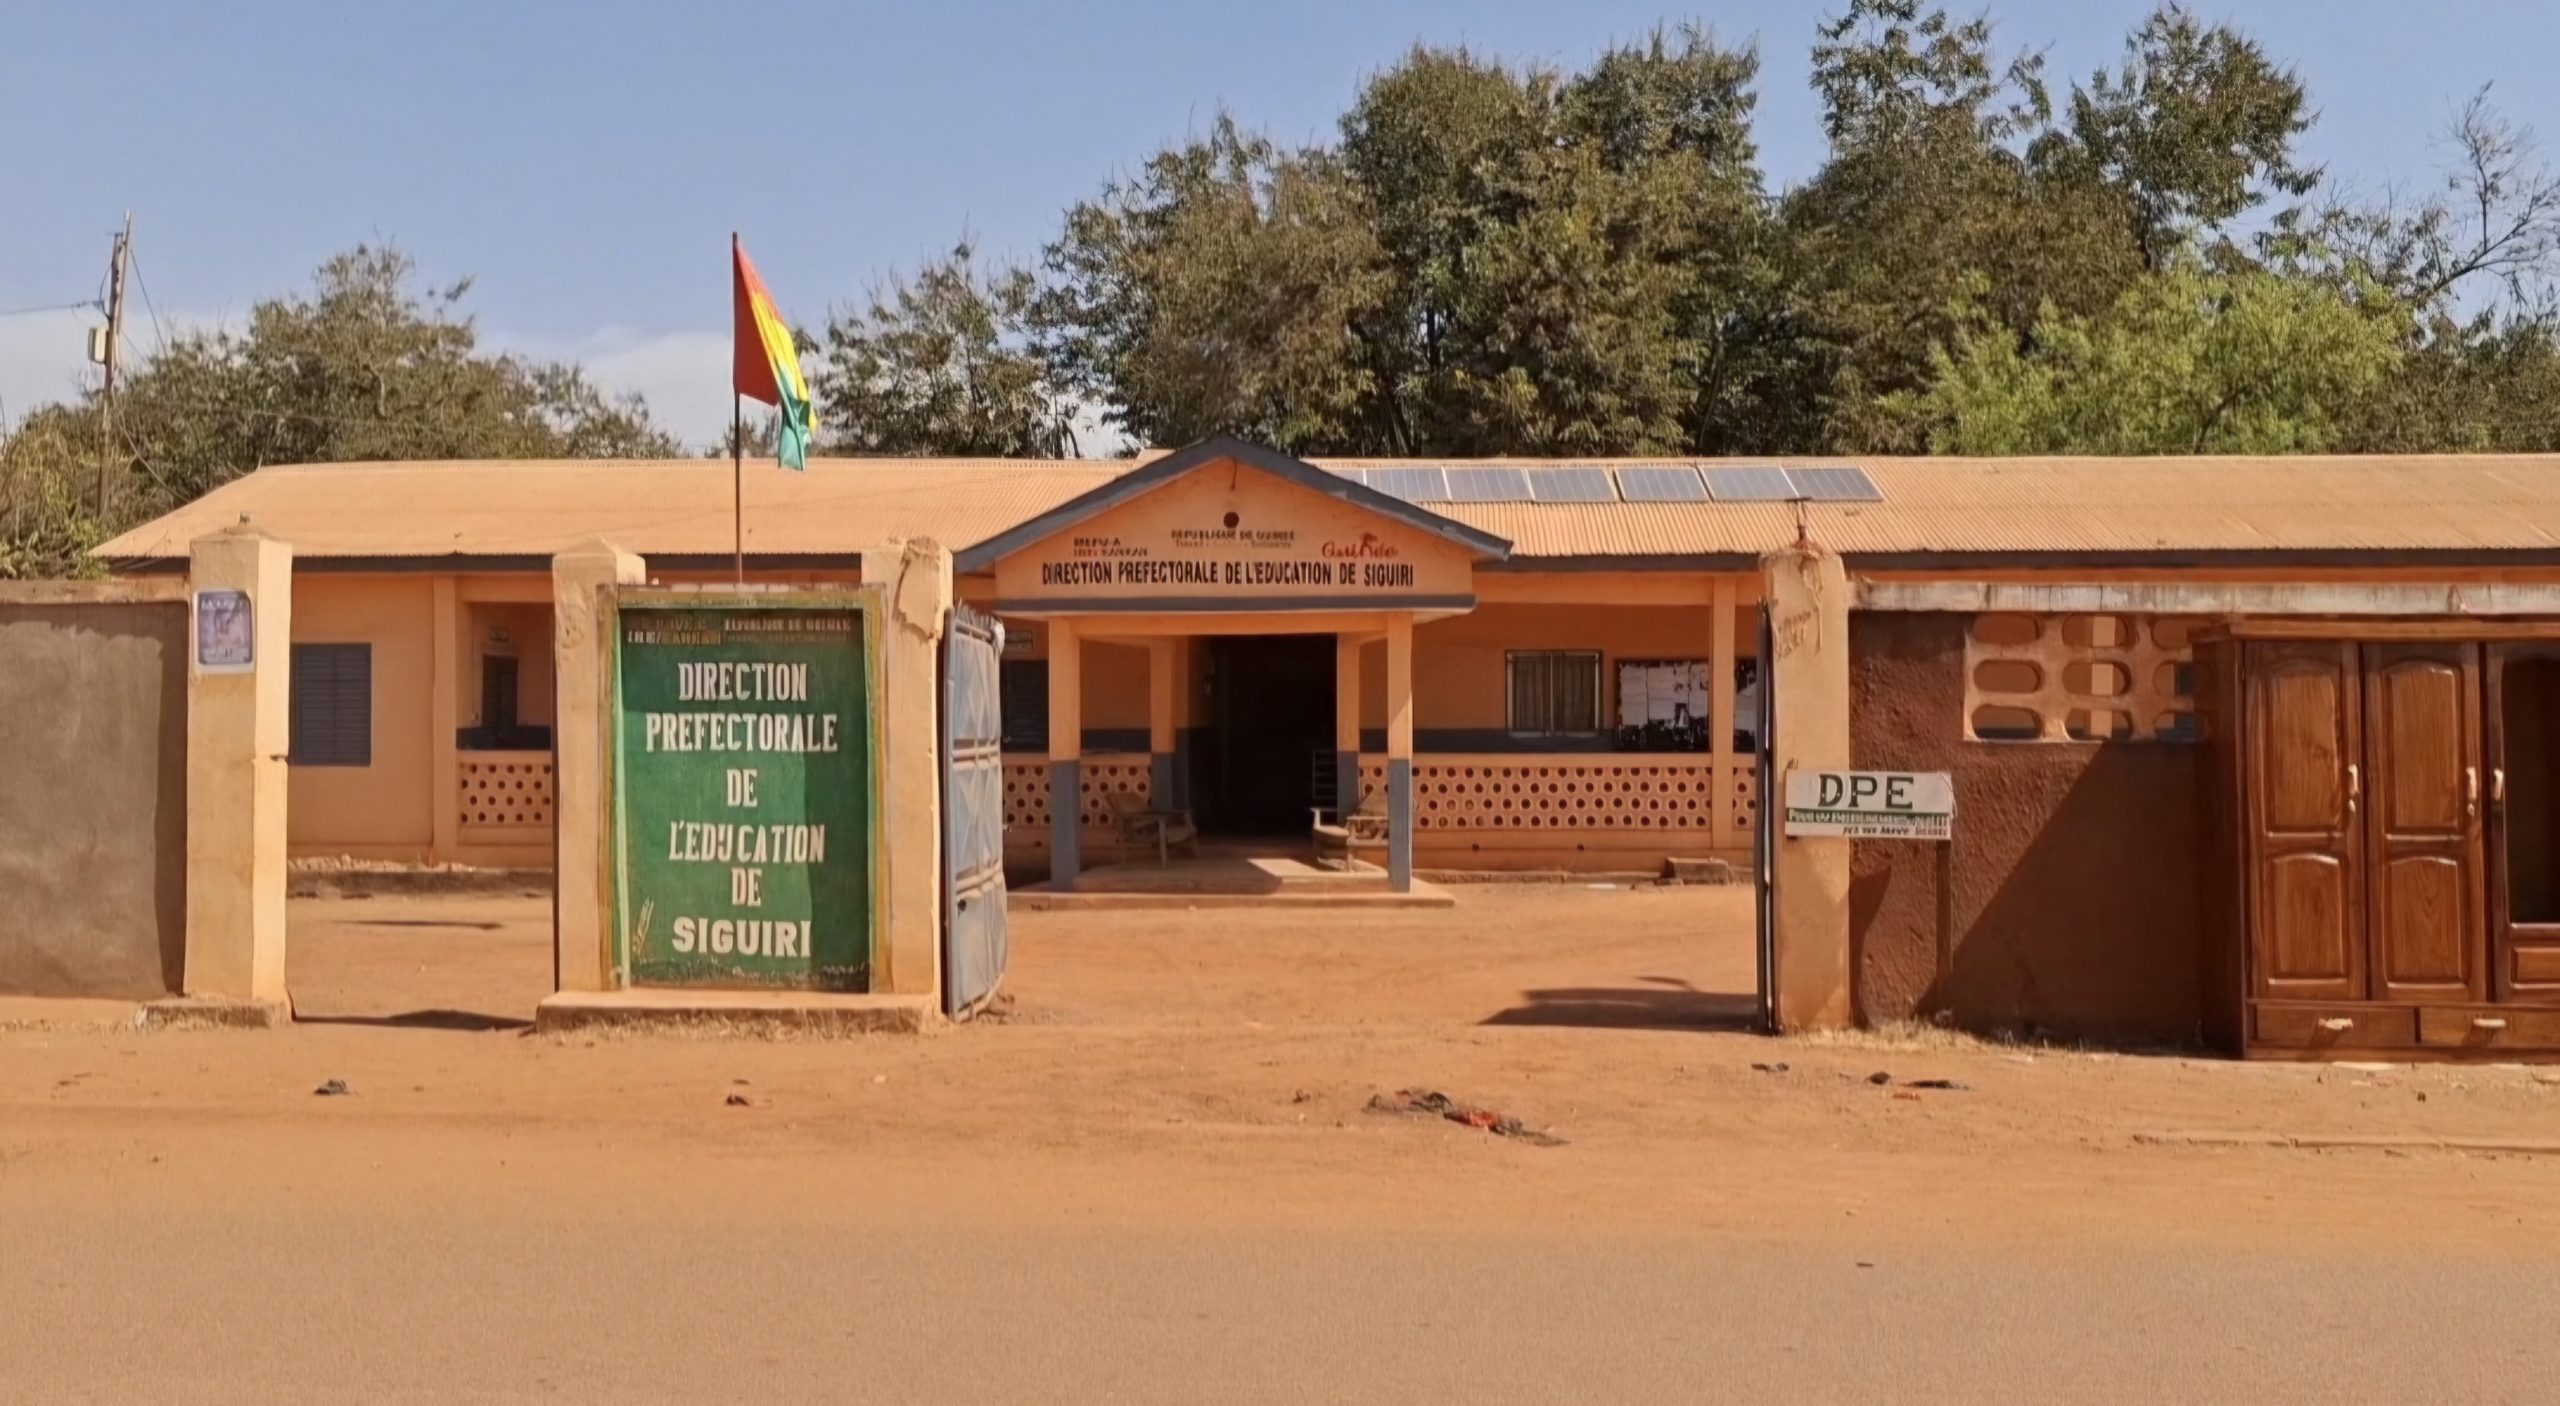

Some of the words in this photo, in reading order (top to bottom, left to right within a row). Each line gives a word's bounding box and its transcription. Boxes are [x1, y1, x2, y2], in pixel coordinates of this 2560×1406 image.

[1042, 561, 1112, 585] DIRECTION
[1118, 560, 1218, 585] PREFECTORALE
[1225, 561, 1242, 585] DE
[1246, 560, 1332, 585] L'EDUCATION
[1339, 562, 1356, 585] DE
[1363, 563, 1414, 587] SIGUIRI
[678, 662, 808, 701] DIRECTION
[645, 713, 839, 753] PREFECTORALE
[726, 768, 759, 808] DE
[1817, 773, 1915, 810] DPE
[669, 821, 826, 864] L'EDUCATION
[730, 868, 762, 908] DE
[672, 916, 813, 958] SIGUIRI
